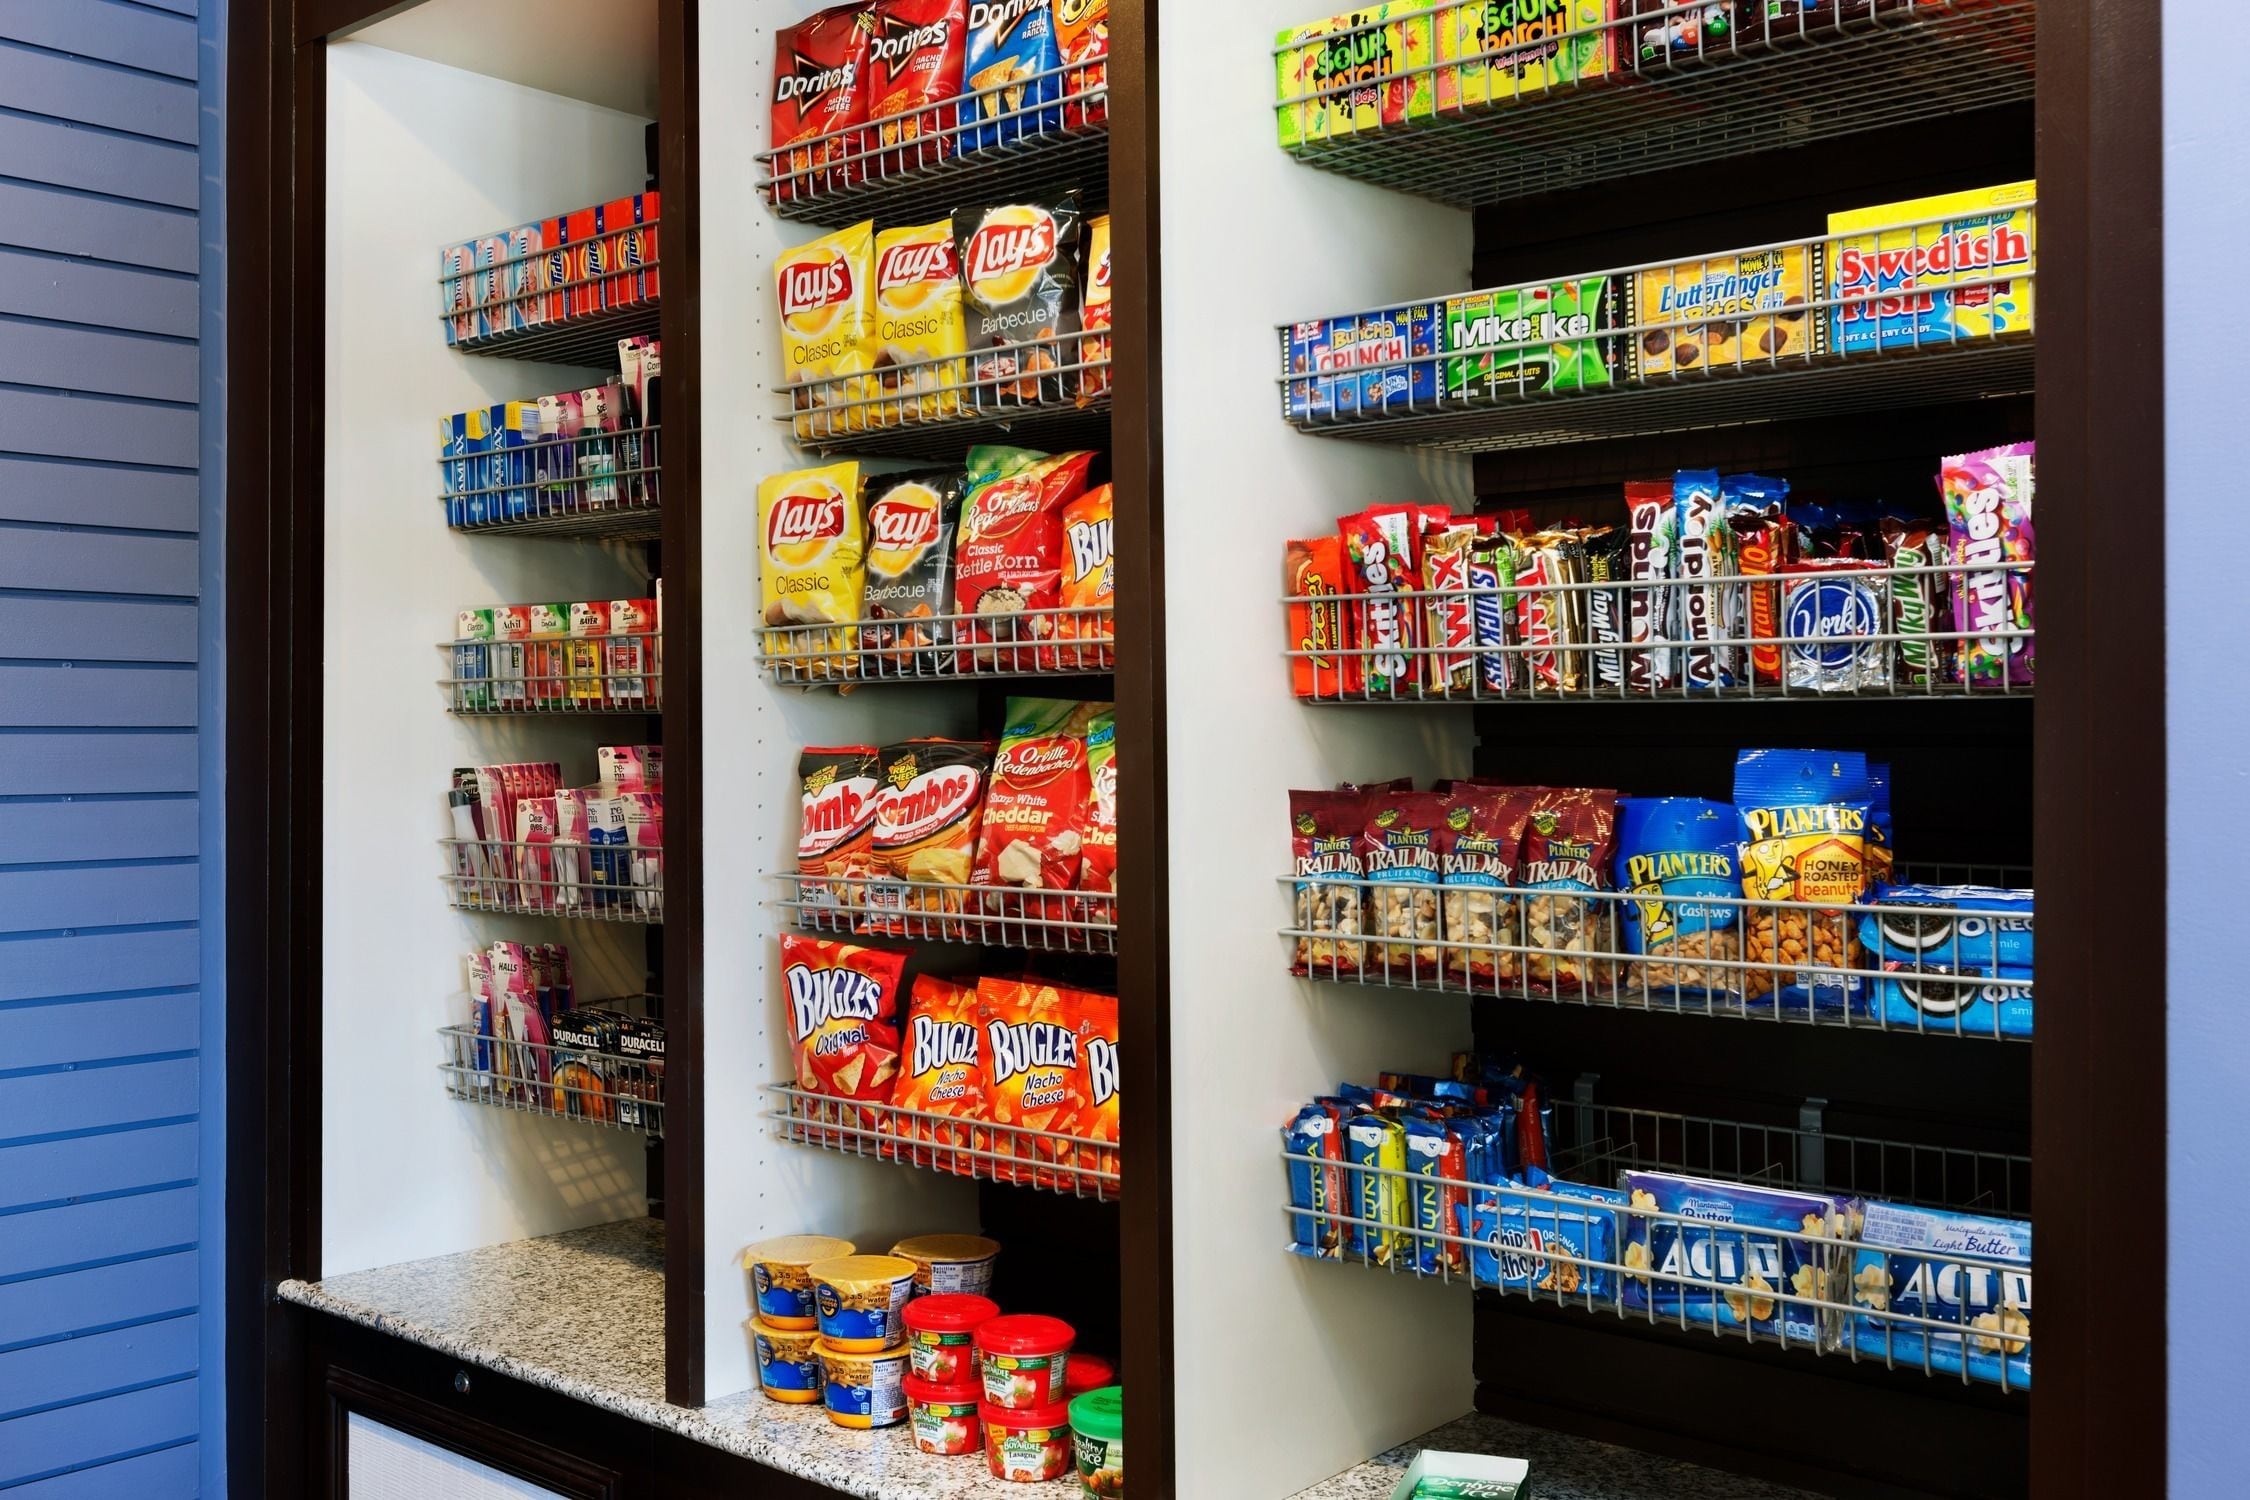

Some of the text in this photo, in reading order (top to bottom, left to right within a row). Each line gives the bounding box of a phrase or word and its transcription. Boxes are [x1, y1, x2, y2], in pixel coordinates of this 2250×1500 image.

[870, 18, 948, 63] Doritos
[1318, 32, 1386, 76] SOUR
[777, 63, 856, 102] Doritos
[1316, 56, 1391, 105] PATCH
[879, 238, 954, 291] Lay's
[971, 222, 1050, 282] Lay's
[1838, 226, 2028, 284] Swedish
[784, 259, 845, 318] Lay's
[1659, 269, 1784, 313] Butterfinger
[1838, 278, 1934, 321] Fish
[882, 316, 938, 342] Classic
[981, 307, 1046, 335] Barbecue
[1452, 316, 1531, 349] Mike
[1540, 312, 1589, 340] Ike
[1838, 325, 1931, 343] SOFT & CEWY CADY
[1333, 322, 1394, 349] Buncha
[793, 339, 842, 366] Classic
[1320, 340, 1403, 378] CRUNCH
[1484, 367, 1541, 381] ORGINAL FUITS
[773, 492, 845, 547] Lay's
[967, 543, 1004, 556] Classic
[956, 555, 1040, 580] Kettle Korn
[1965, 487, 2023, 656] Skittles
[775, 572, 830, 596] Classic
[864, 582, 925, 602] Barbecue
[1302, 571, 1331, 669] Reese's
[1363, 541, 1407, 678] Skittles
[1684, 554, 1715, 680] Almond
[1472, 570, 1502, 689] SNICKRS
[1591, 589, 1620, 683] Mily Way
[1797, 598, 1858, 656] York
[800, 784, 878, 837] omb
[1016, 794, 1048, 807] White
[982, 806, 1053, 826] Cheddar
[1749, 807, 1864, 841] PLANTERS
[1314, 839, 1351, 853] PLANTERS
[1388, 833, 1429, 845] PLANTERS
[1455, 839, 1499, 854] PLANTERS
[1549, 844, 1591, 859] PLANTERS
[1338, 852, 1366, 878] MIX
[1366, 847, 1441, 872] TRAIL MIX
[1483, 854, 1513, 885] MIX
[1629, 851, 1732, 882] PLANTERS
[1804, 859, 1860, 871] HONEY
[1377, 869, 1403, 879] FRUIT
[1413, 871, 1429, 879] NUT
[1527, 860, 1600, 890] TRAIL MIX
[1803, 871, 1859, 882] ROASTED
[1803, 882, 1860, 901] peanuts
[1679, 902, 1732, 919] Cashews
[1989, 939, 2021, 949] smile
[498, 962, 518, 972] HALLS
[787, 964, 881, 1042] BUGLES
[553, 1028, 600, 1048] DURACELL
[936, 1069, 966, 1088] Nacho
[1024, 1072, 1063, 1092] Nacho
[929, 1085, 964, 1102] Cheese
[1021, 1088, 1064, 1109] Cheese
[1308, 1142, 1326, 1225] LUNA
[1363, 1152, 1378, 1237] LUNA
[1421, 1162, 1437, 1248] LUNA
[1681, 1207, 1733, 1223] Butter
[1489, 1230, 1532, 1257] Chips
[1542, 1231, 1579, 1255] ORGINAL
[1932, 1238, 1964, 1253] Light
[1965, 1236, 2016, 1256] Butter
[1659, 1238, 1736, 1278] ACT
[795, 1276, 812, 1284] wate
[1896, 1262, 1992, 1307] ACT
[1009, 1451, 1037, 1461] Lasagna
